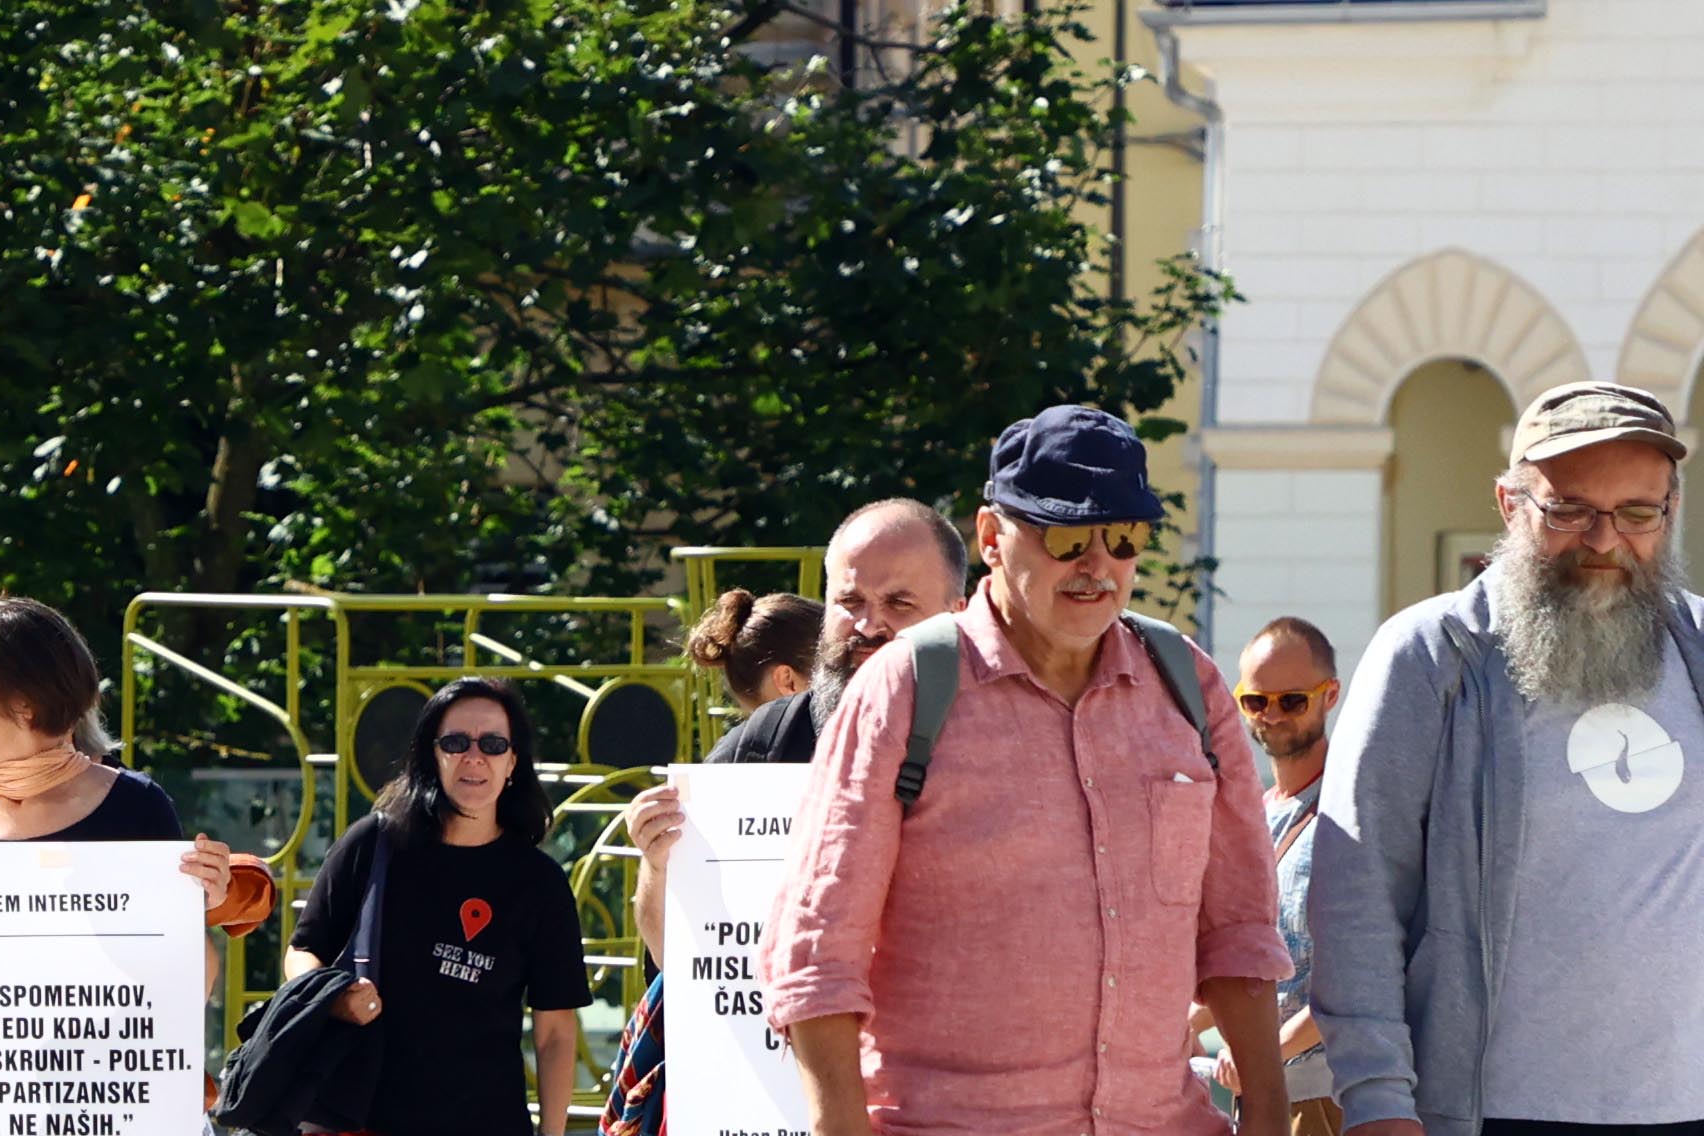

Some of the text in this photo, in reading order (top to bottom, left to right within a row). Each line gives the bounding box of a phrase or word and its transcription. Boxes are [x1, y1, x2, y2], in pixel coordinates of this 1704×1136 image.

[738, 817, 792, 836] IZJAV
[29, 893, 129, 912] INTERESU?
[432, 943, 496, 970] SEE YOU
[439, 960, 481, 983] HERE
[692, 957, 758, 980] MISL
[0, 985, 151, 1009] SPOMENIKOV,
[54, 1017, 109, 1039] KDAJ
[119, 1017, 153, 1039] JIH
[110, 1049, 191, 1071] POLETI.
[10, 1114, 37, 1136] NE
[46, 1109, 133, 1136] NAŠIH.”
